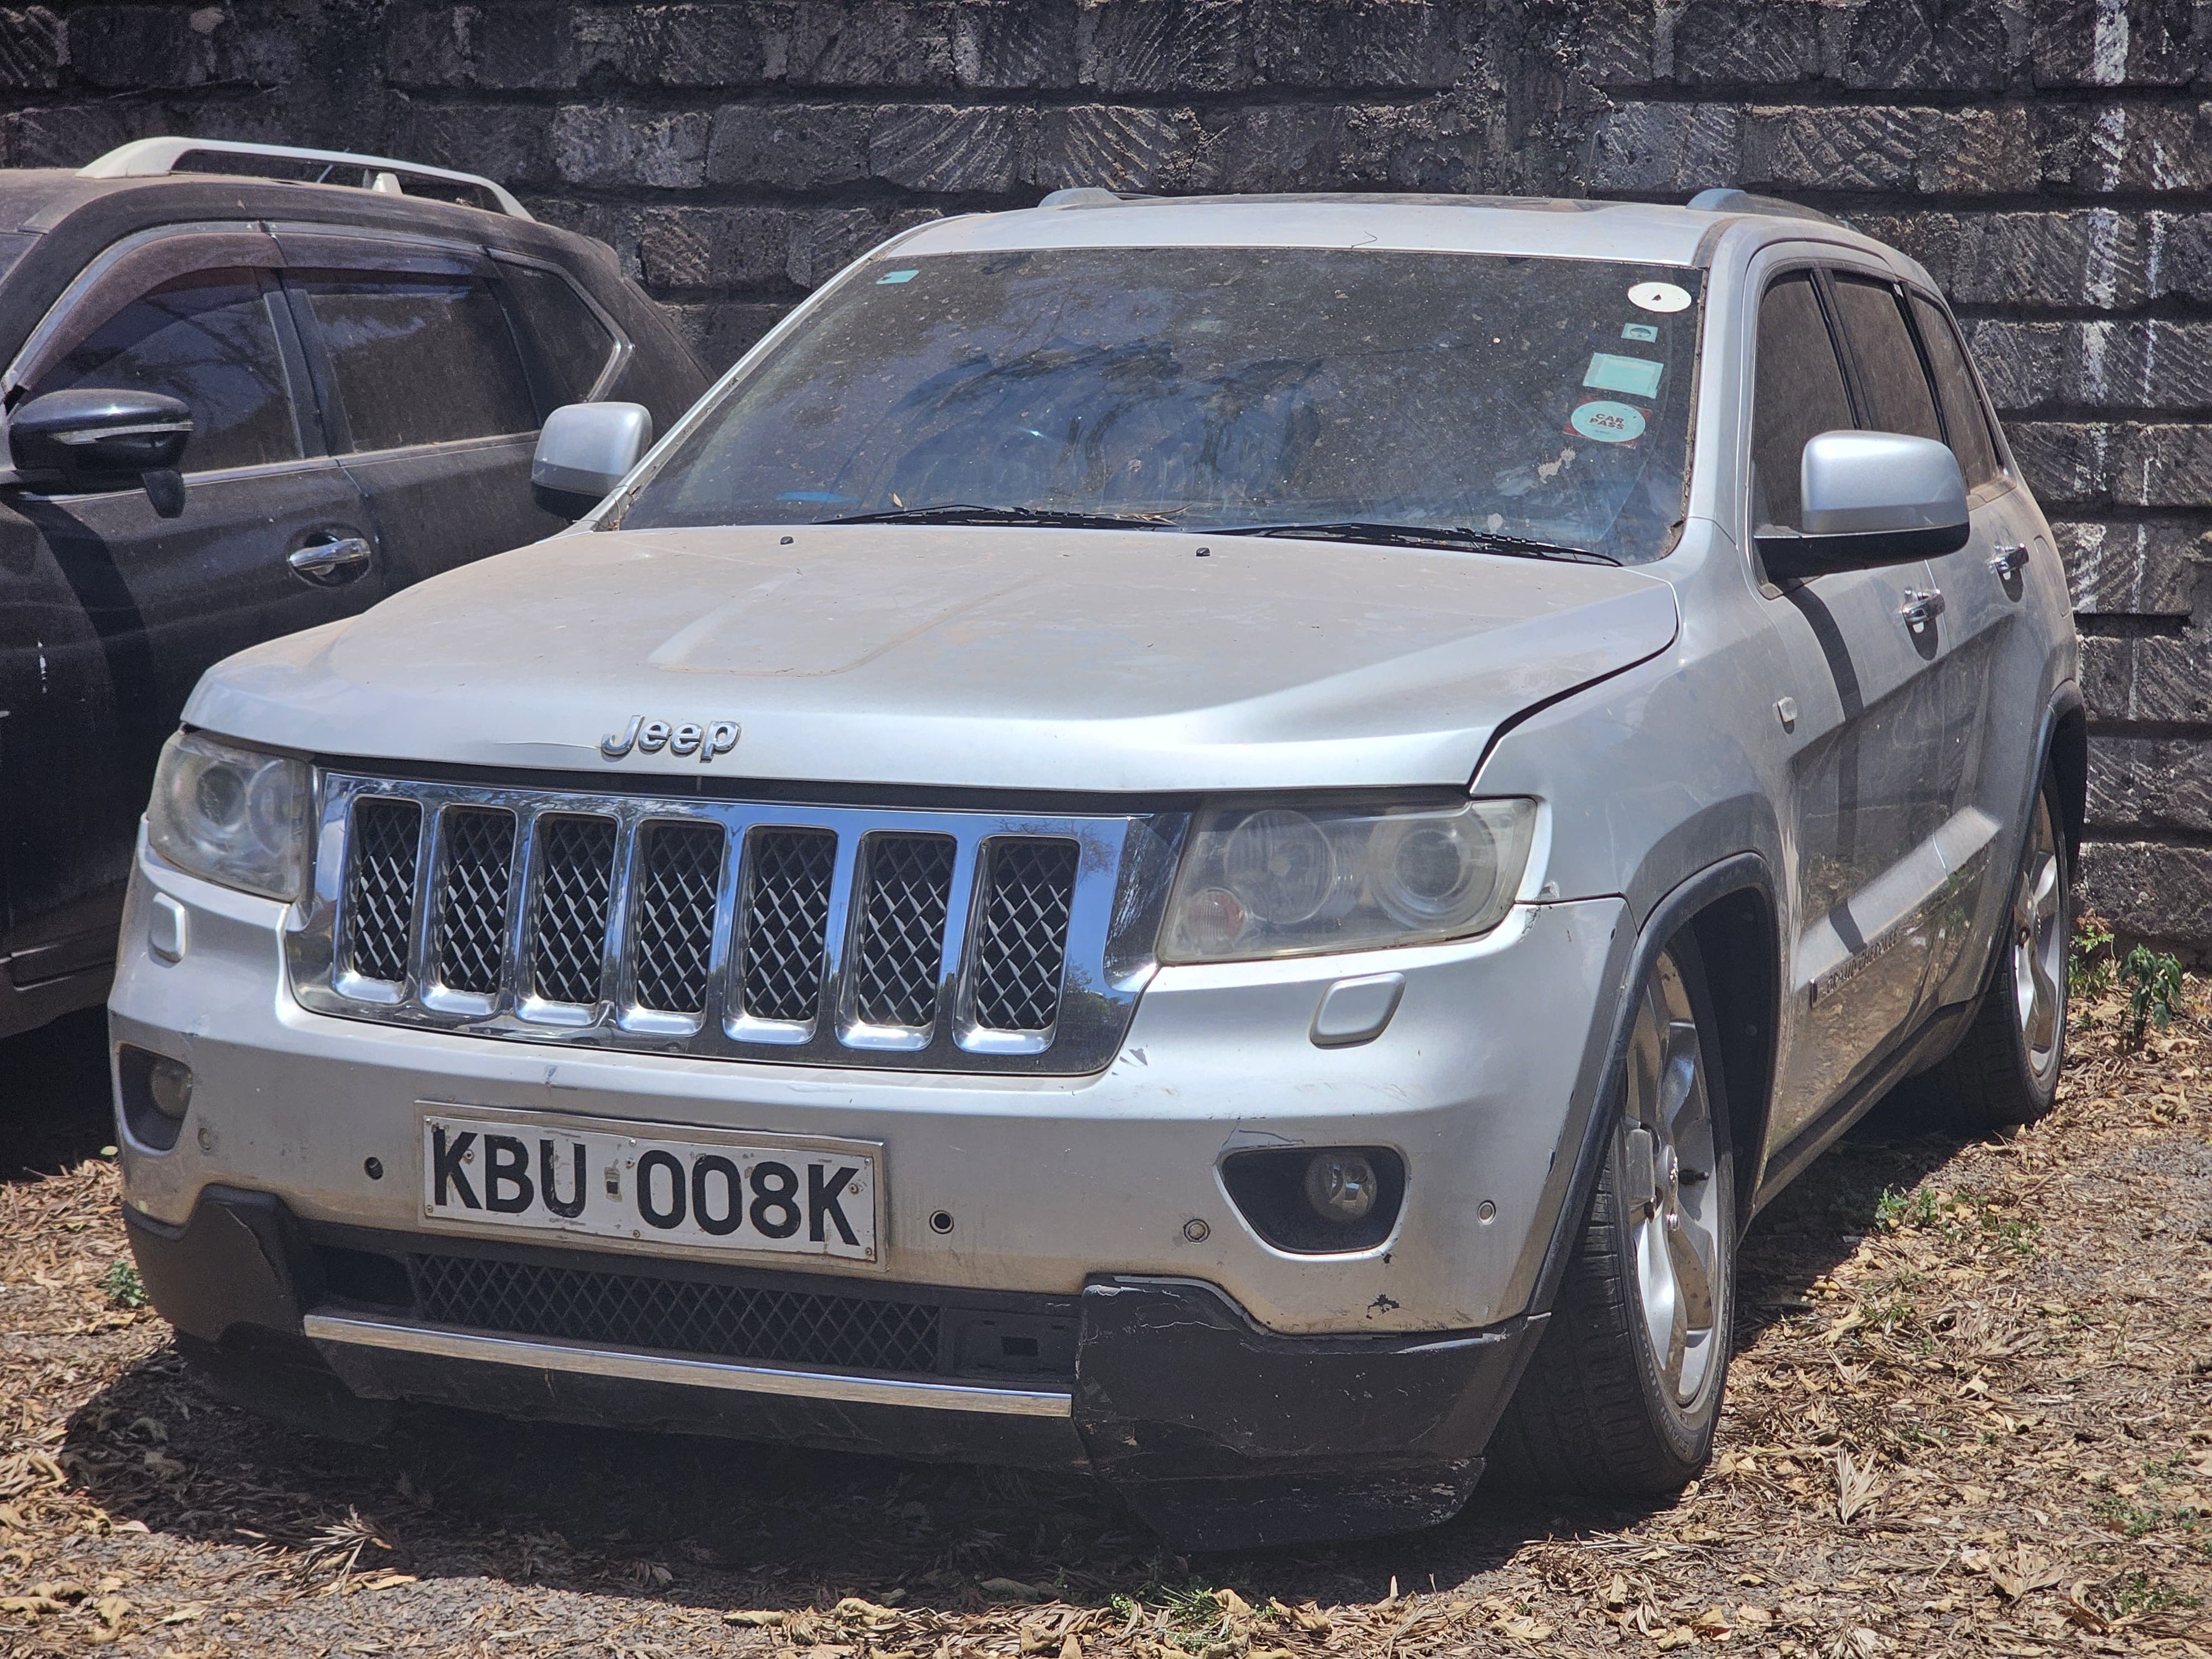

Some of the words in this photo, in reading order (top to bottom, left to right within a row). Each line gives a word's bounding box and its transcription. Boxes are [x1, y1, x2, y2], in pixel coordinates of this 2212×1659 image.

[1589, 418, 1625, 429] PASS
[1596, 414, 1624, 424] CAR
[601, 715, 742, 761] Jeep
[432, 1126, 587, 1219] KBU
[637, 1150, 861, 1247] 008K
